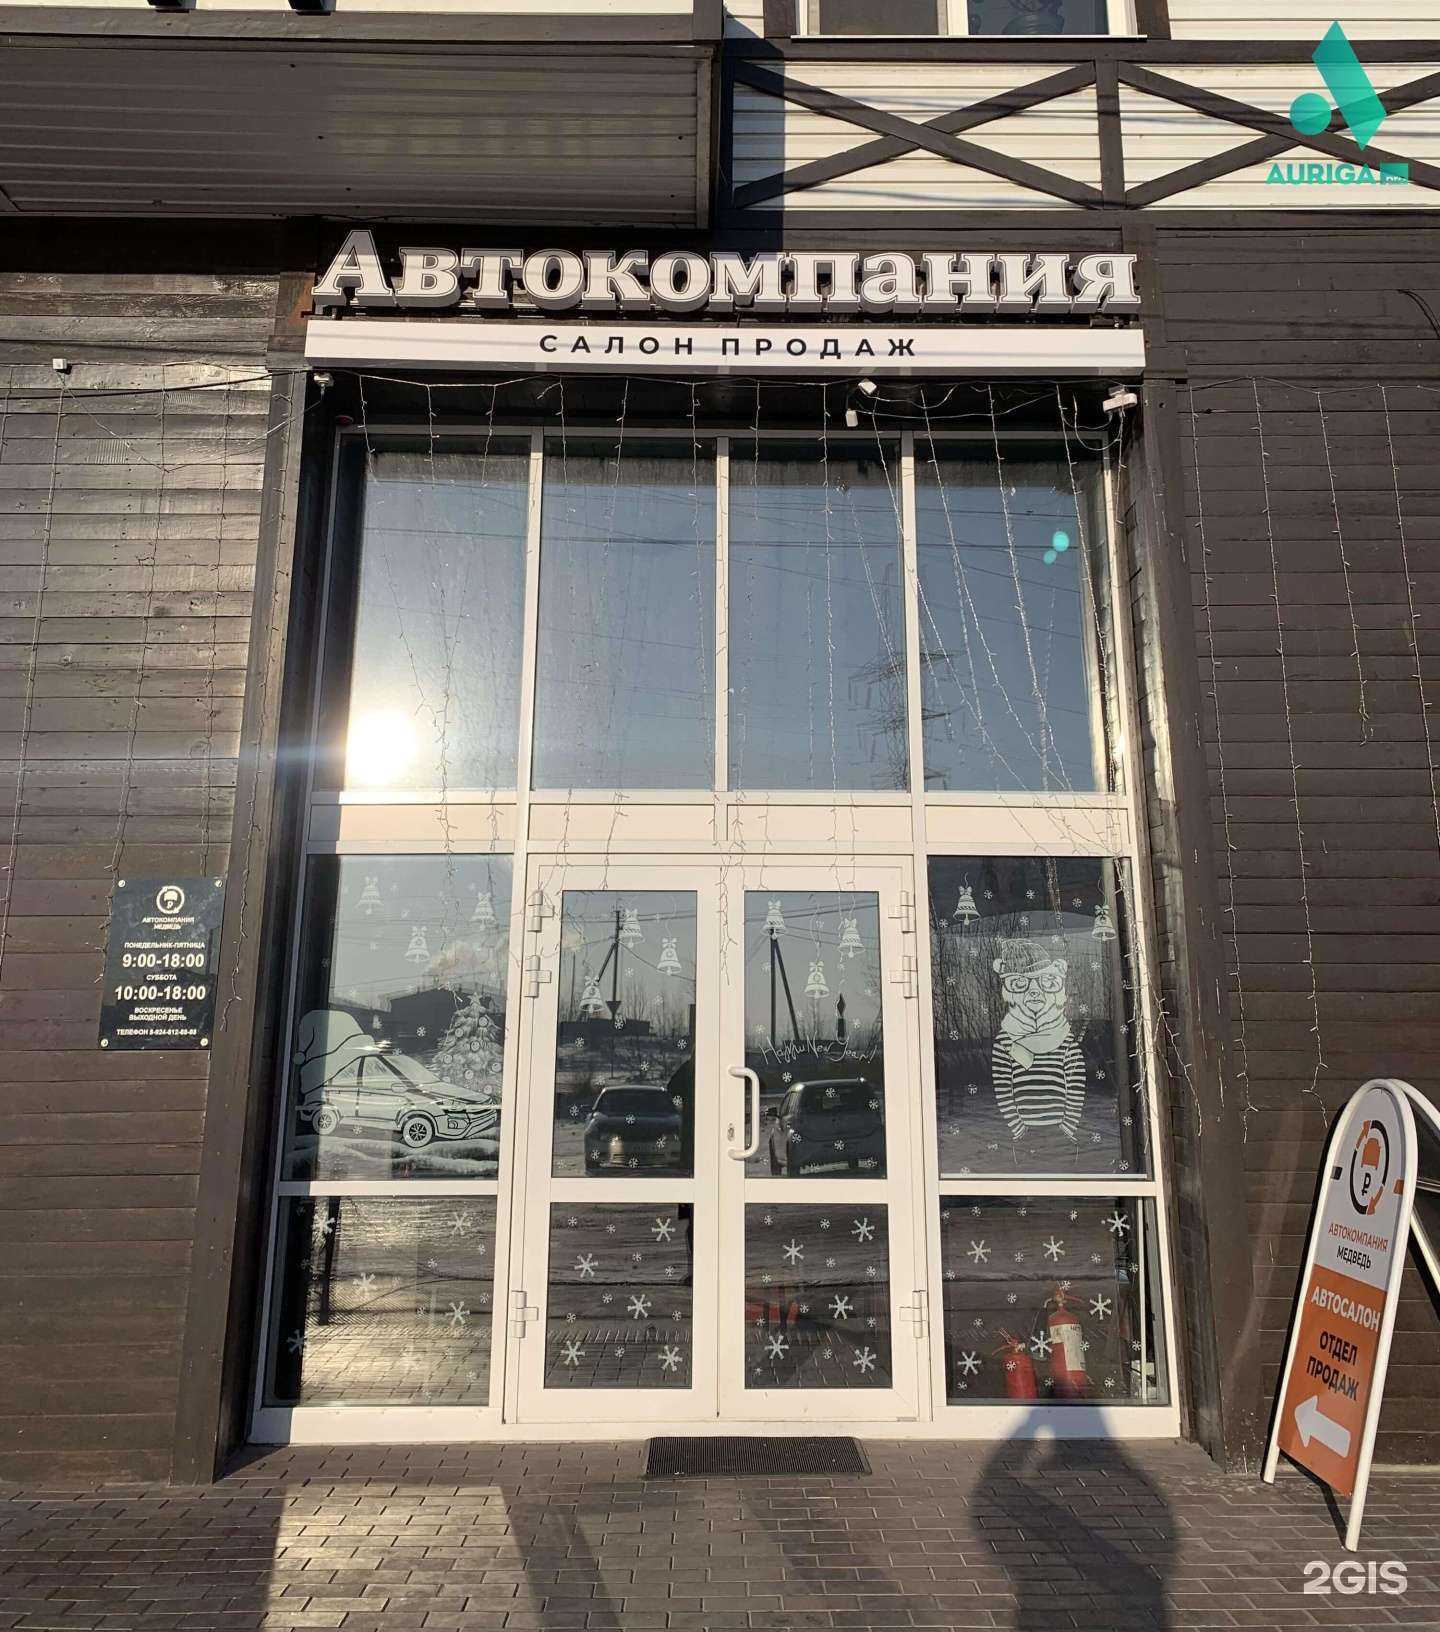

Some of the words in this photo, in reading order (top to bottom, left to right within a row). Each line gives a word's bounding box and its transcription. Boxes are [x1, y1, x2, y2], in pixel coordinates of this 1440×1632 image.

[539, 334, 693, 355] САЛОН
[721, 338, 916, 360] ПРОДАЖ
[122, 953, 205, 968] 9:00-18:00
[115, 986, 206, 1000] 10:00-18:00
[128, 1013, 168, 1021] ВЫХОДНОЙ
[1328, 1223, 1388, 1252] АВТОКОМПАНИЯ
[1337, 1245, 1371, 1270] МЕДВЕДЬ
[1311, 1286, 1381, 1332] АВТОСАЛОН
[1320, 1331, 1358, 1366] ОТДЕЛ
[1306, 1356, 1359, 1401] ПРОДАЖ
